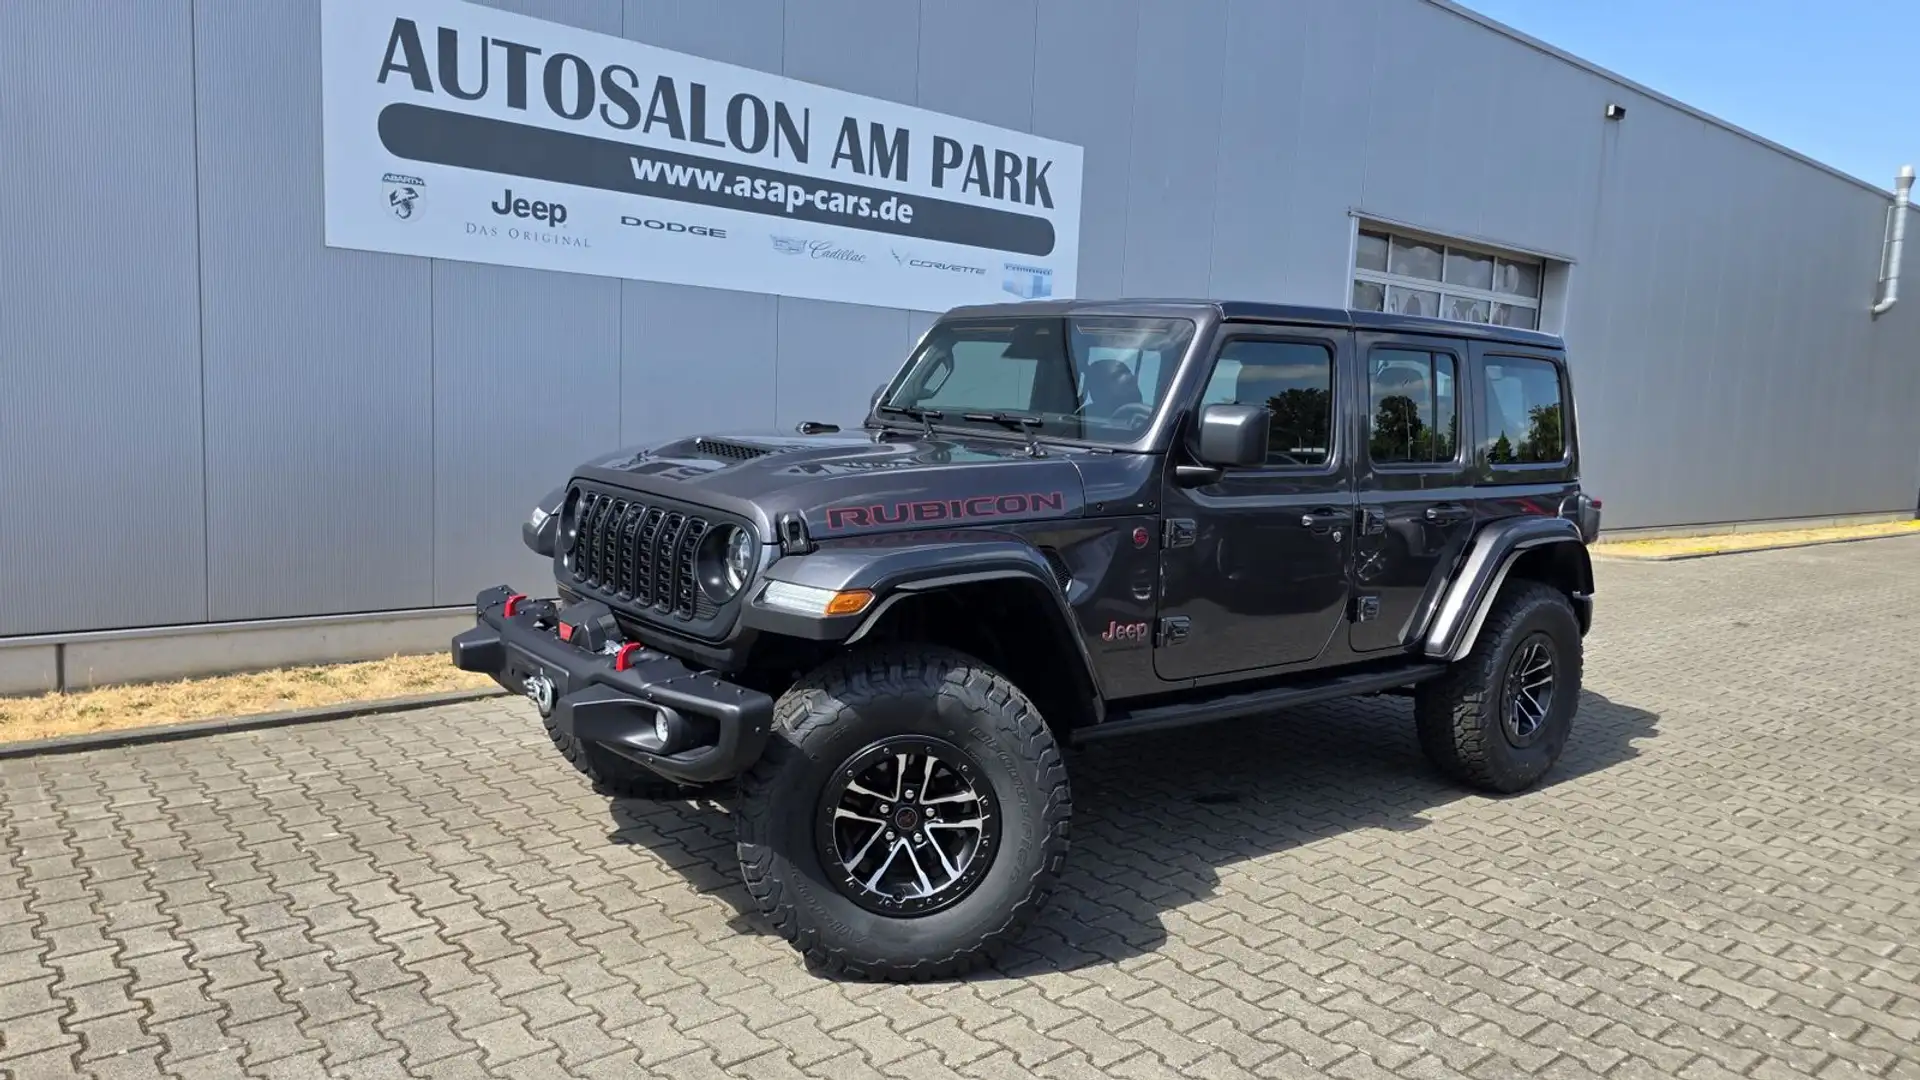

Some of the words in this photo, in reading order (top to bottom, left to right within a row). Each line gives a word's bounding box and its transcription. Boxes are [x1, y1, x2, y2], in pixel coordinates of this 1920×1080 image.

[377, 17, 810, 164] AUTOSALON
[830, 116, 909, 182] AM
[931, 135, 1054, 209] PARK
[629, 156, 914, 224] www.asap-cars.de
[491, 189, 567, 227] Jeep
[465, 222, 497, 236] DAS
[508, 228, 591, 248] ORIGINAL
[621, 216, 727, 239] DODGE
[808, 239, 867, 262] Cadillac
[909, 259, 986, 274] CORVETTE
[827, 491, 1064, 530] RUBICON
[1102, 621, 1148, 641] Jeep
